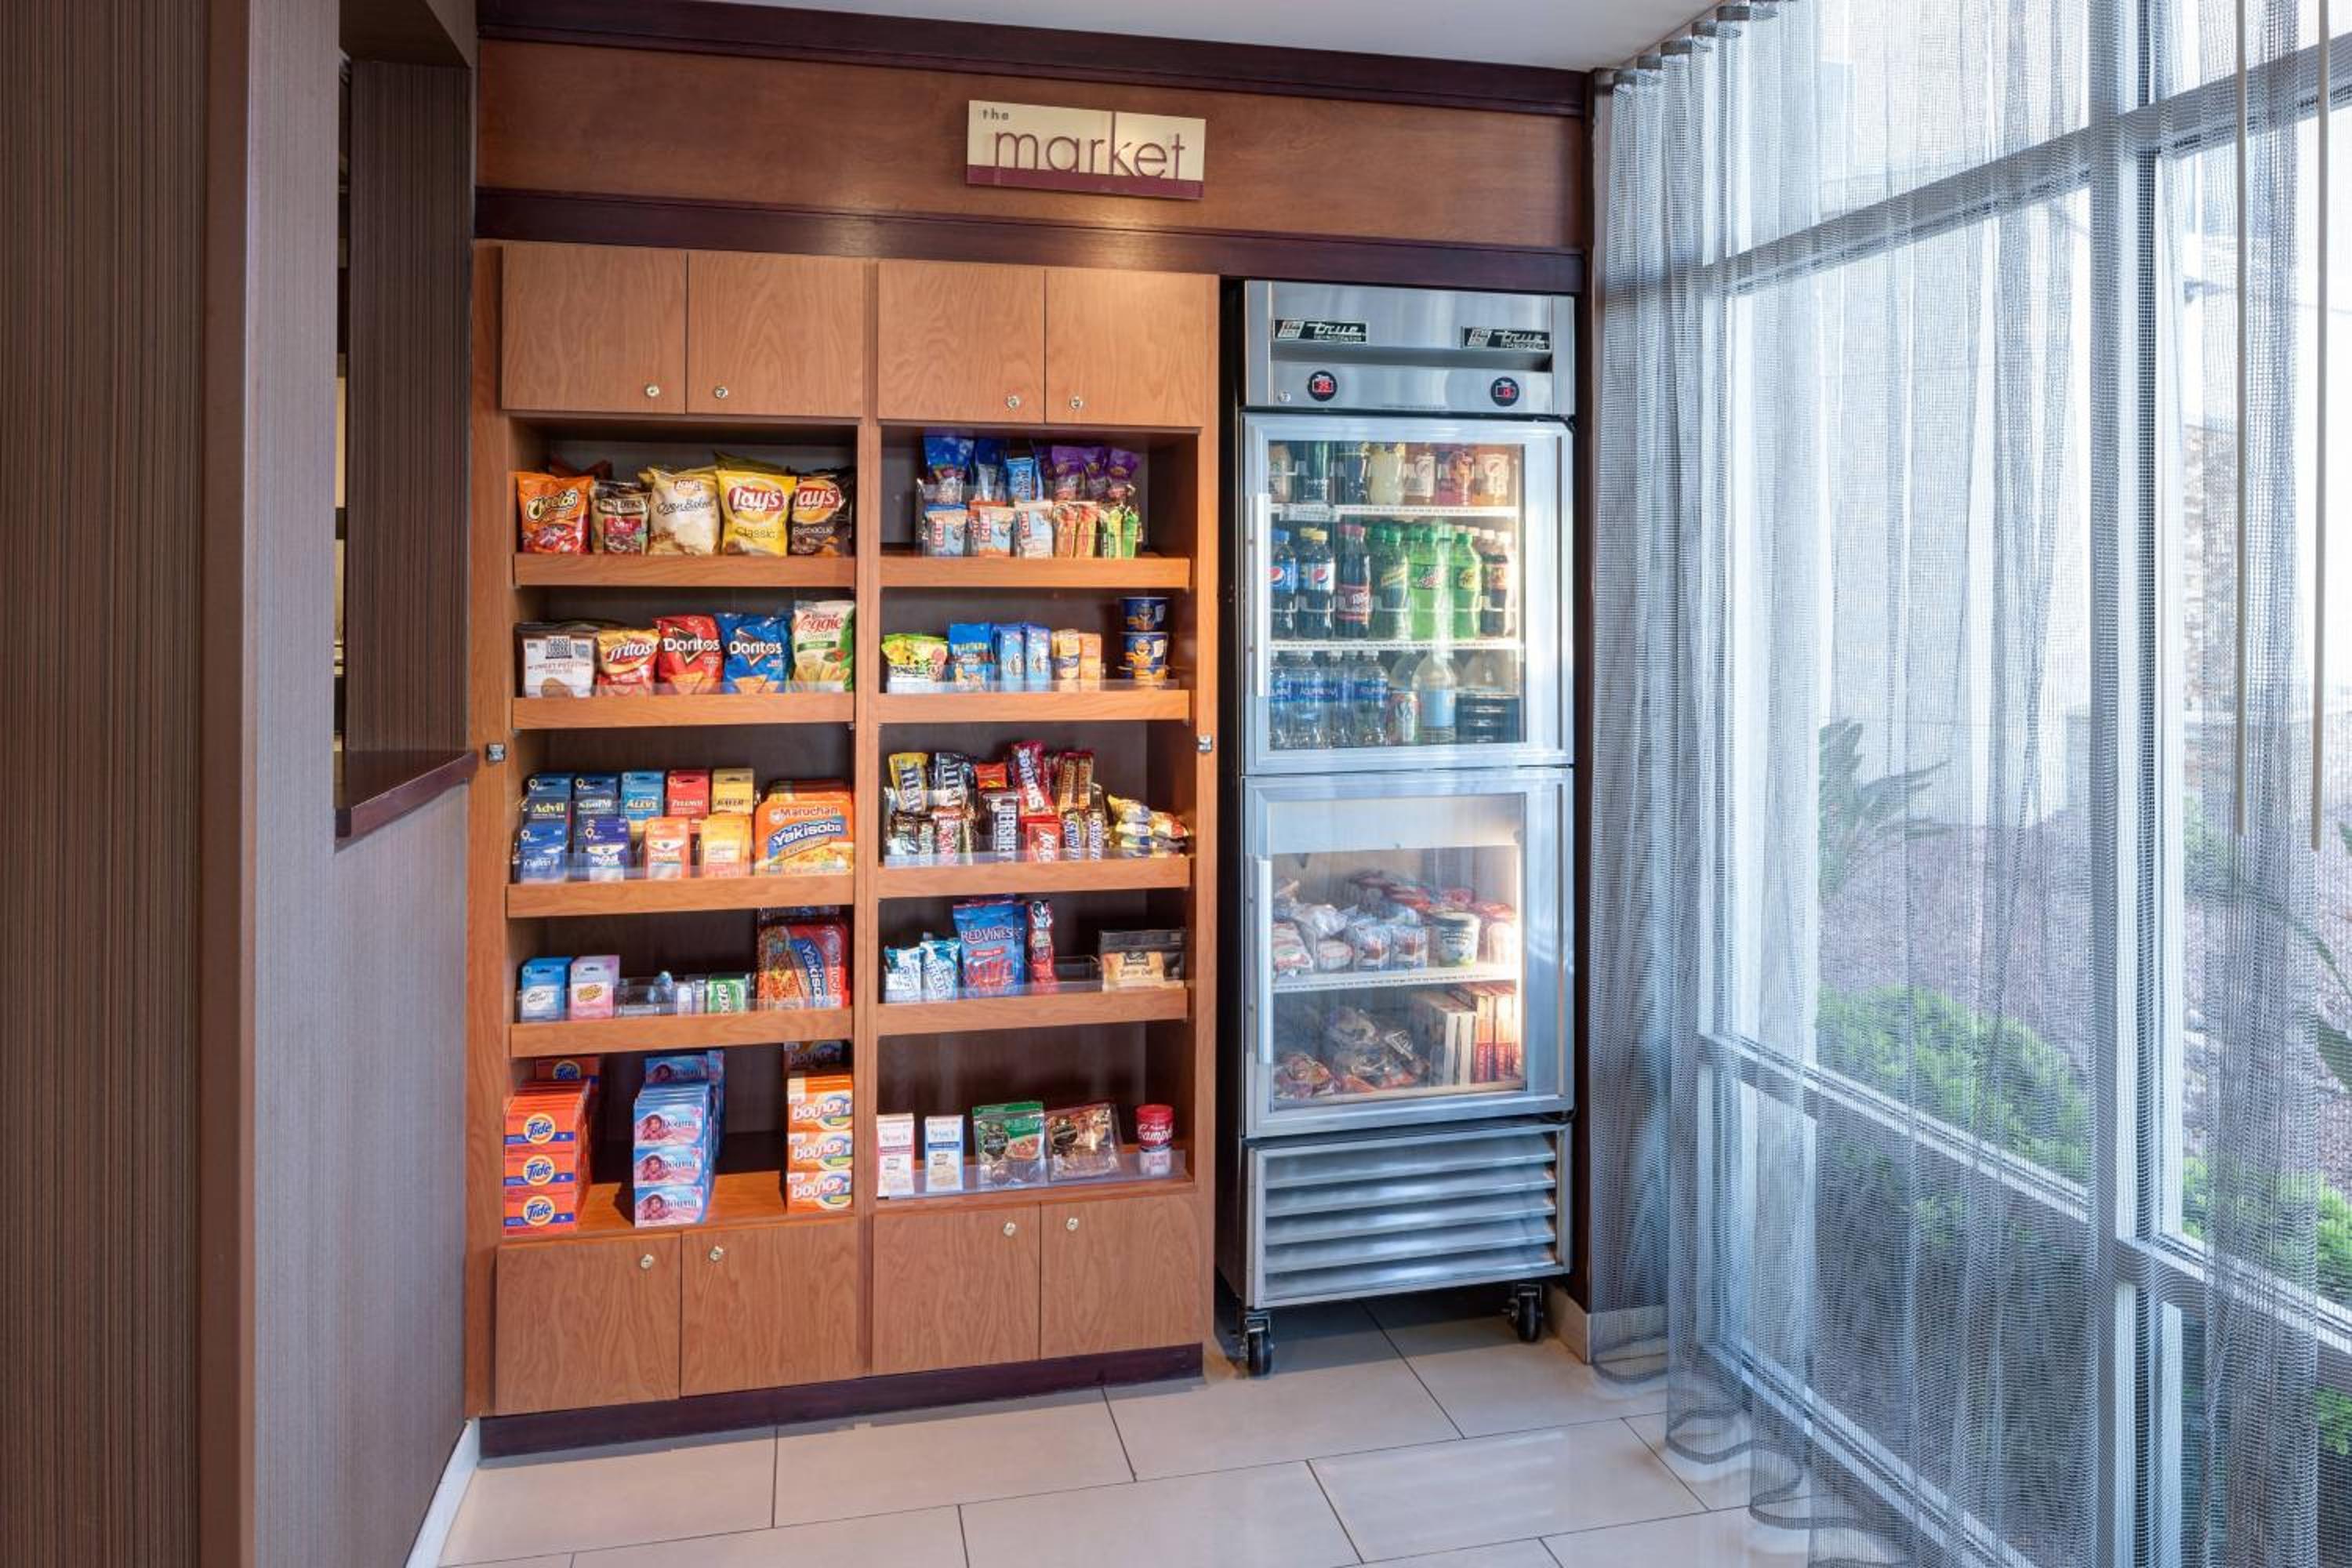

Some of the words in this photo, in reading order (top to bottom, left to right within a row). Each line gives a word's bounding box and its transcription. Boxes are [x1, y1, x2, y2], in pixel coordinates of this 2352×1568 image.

[982, 107, 1009, 120] the
[994, 111, 1185, 181] market
[733, 487, 781, 512] Lay's
[794, 488, 837, 511] ay's
[735, 525, 777, 539] Classic
[664, 637, 720, 652] Doritos
[729, 641, 783, 655] Doritos
[533, 802, 565, 813] Advil
[779, 806, 838, 818] Maruchan
[773, 821, 842, 846] Yakisoba
[527, 1121, 553, 1139] Tide
[526, 1162, 553, 1180] Tide
[527, 1203, 553, 1221] Tide
